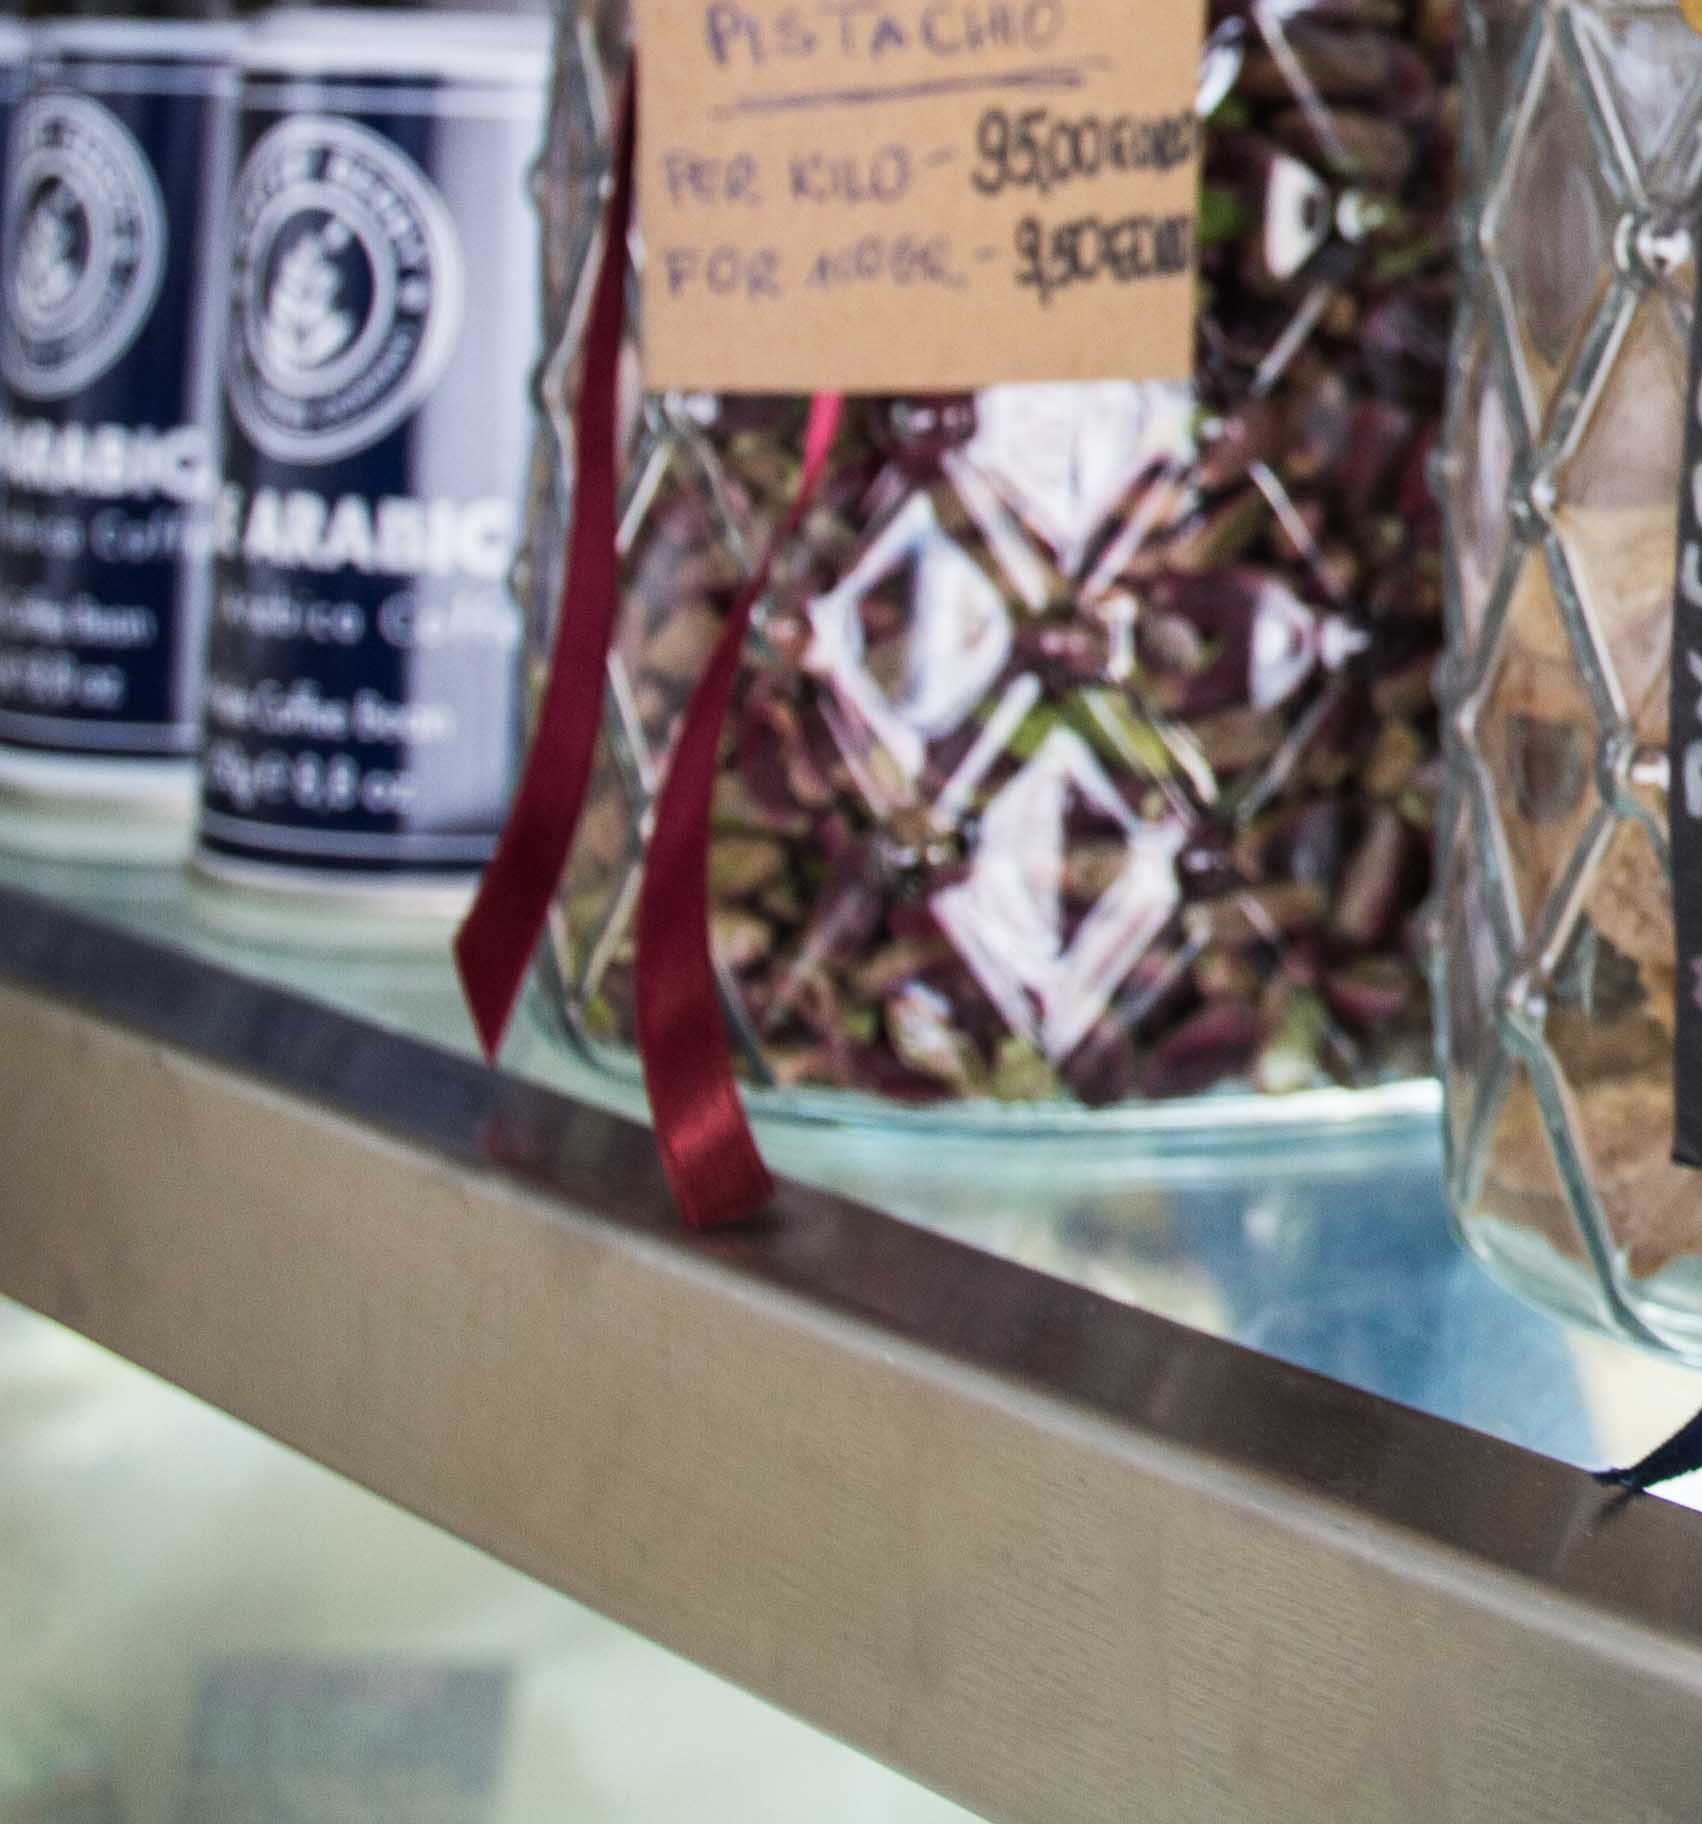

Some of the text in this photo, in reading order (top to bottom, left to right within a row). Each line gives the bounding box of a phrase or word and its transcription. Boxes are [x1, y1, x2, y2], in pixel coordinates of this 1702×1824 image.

[662, 146, 764, 207] PER
[788, 142, 912, 204] KILO
[662, 244, 782, 299] FOR
[243, 484, 514, 578] ARABIC
